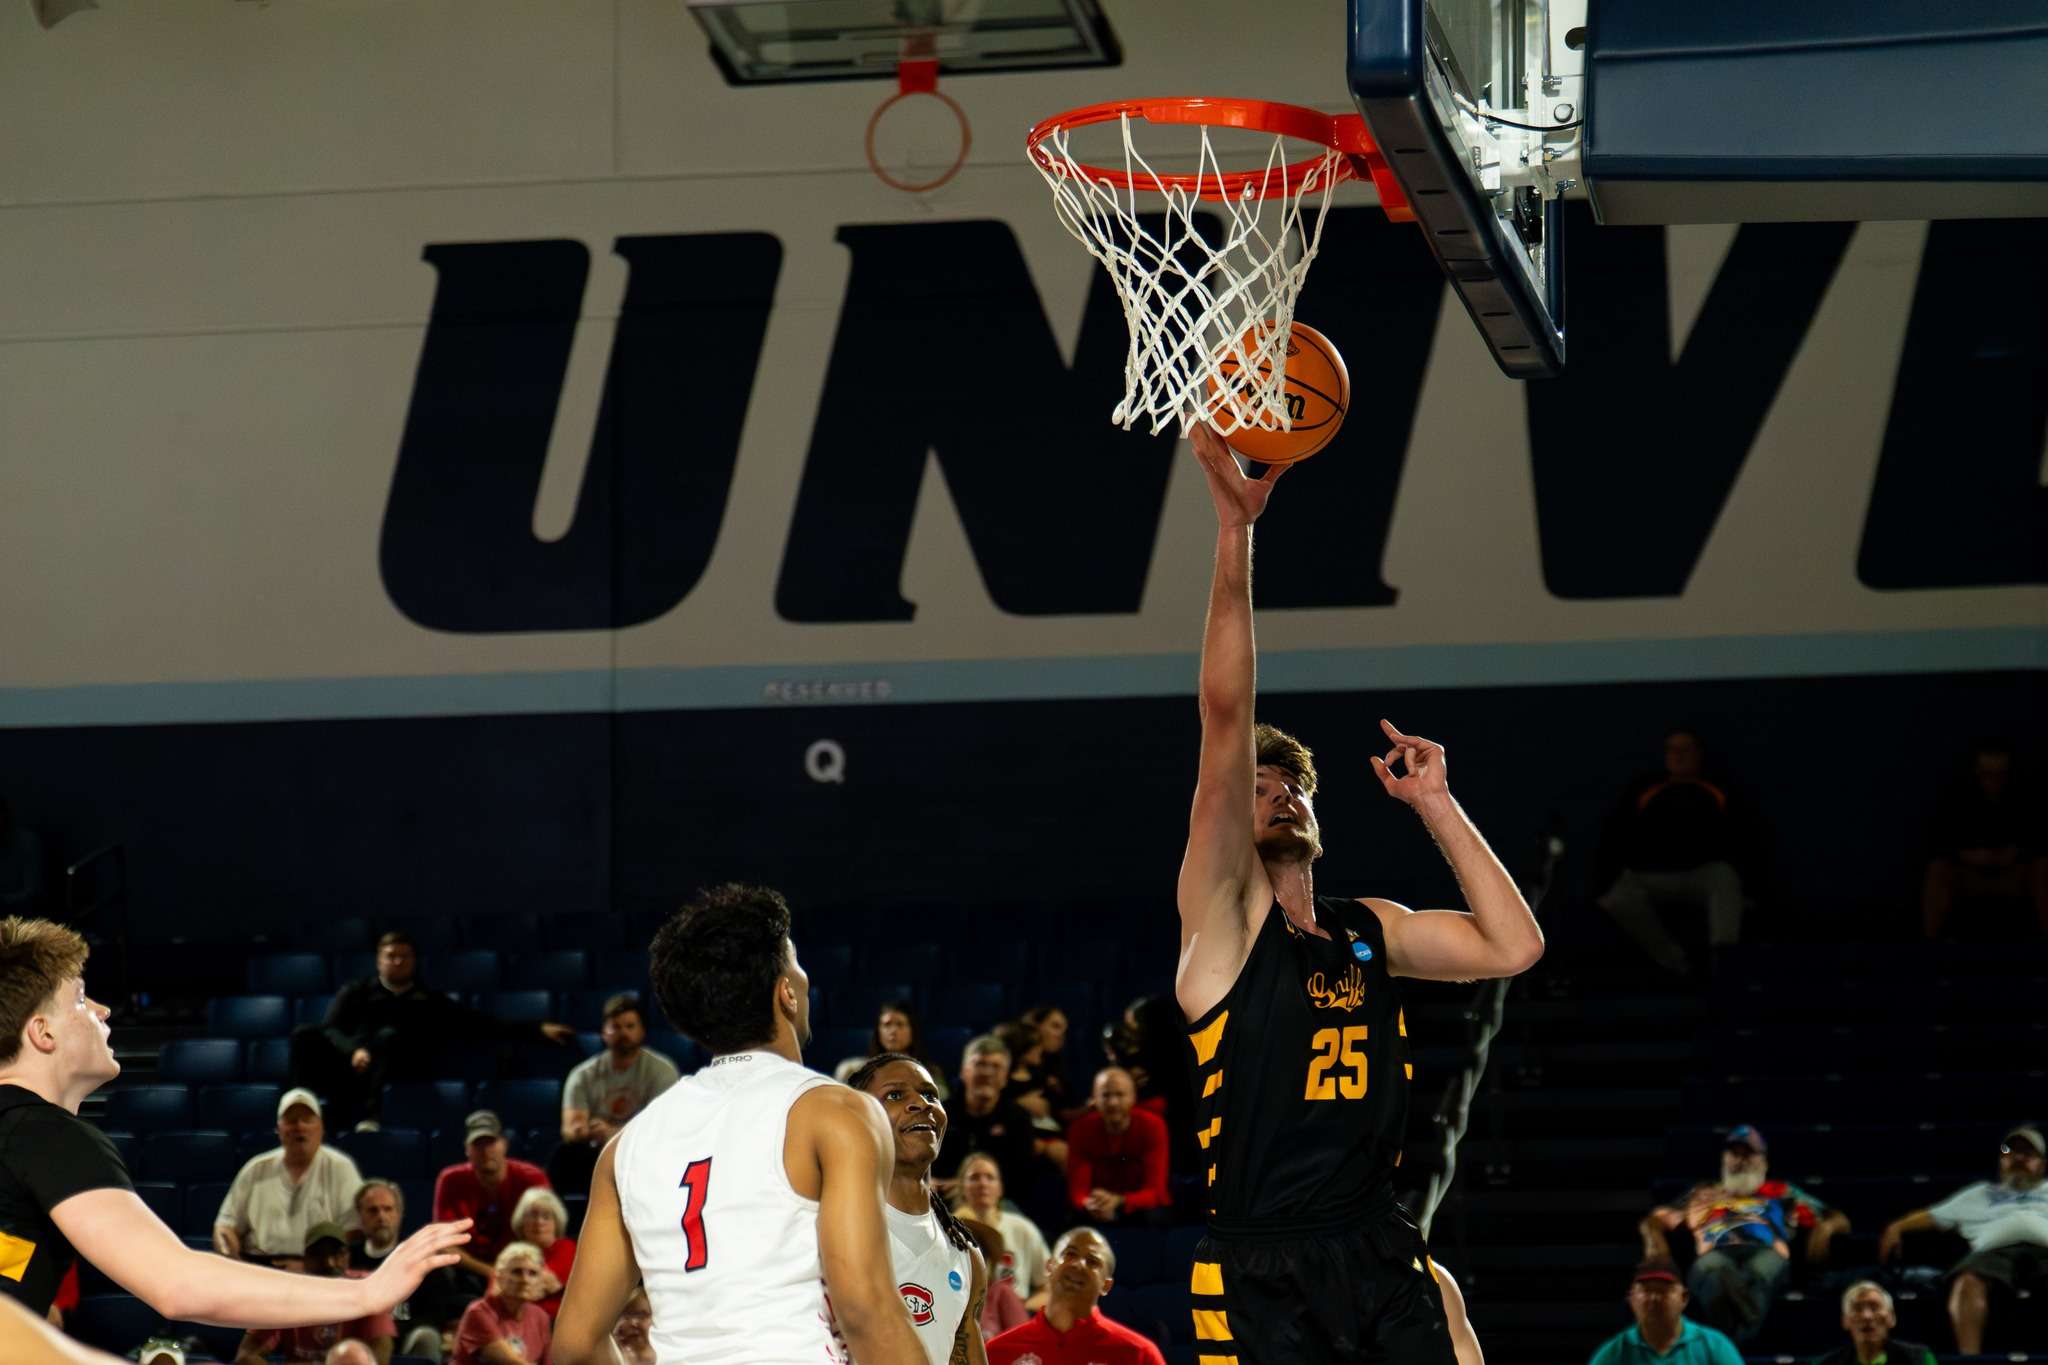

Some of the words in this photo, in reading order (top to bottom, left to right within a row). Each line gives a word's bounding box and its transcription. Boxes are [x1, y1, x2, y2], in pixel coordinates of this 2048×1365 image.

[804, 738, 846, 784] Q
[728, 1054, 753, 1064] PRO
[1304, 1024, 1368, 1101] 25
[679, 1156, 712, 1273] 1
